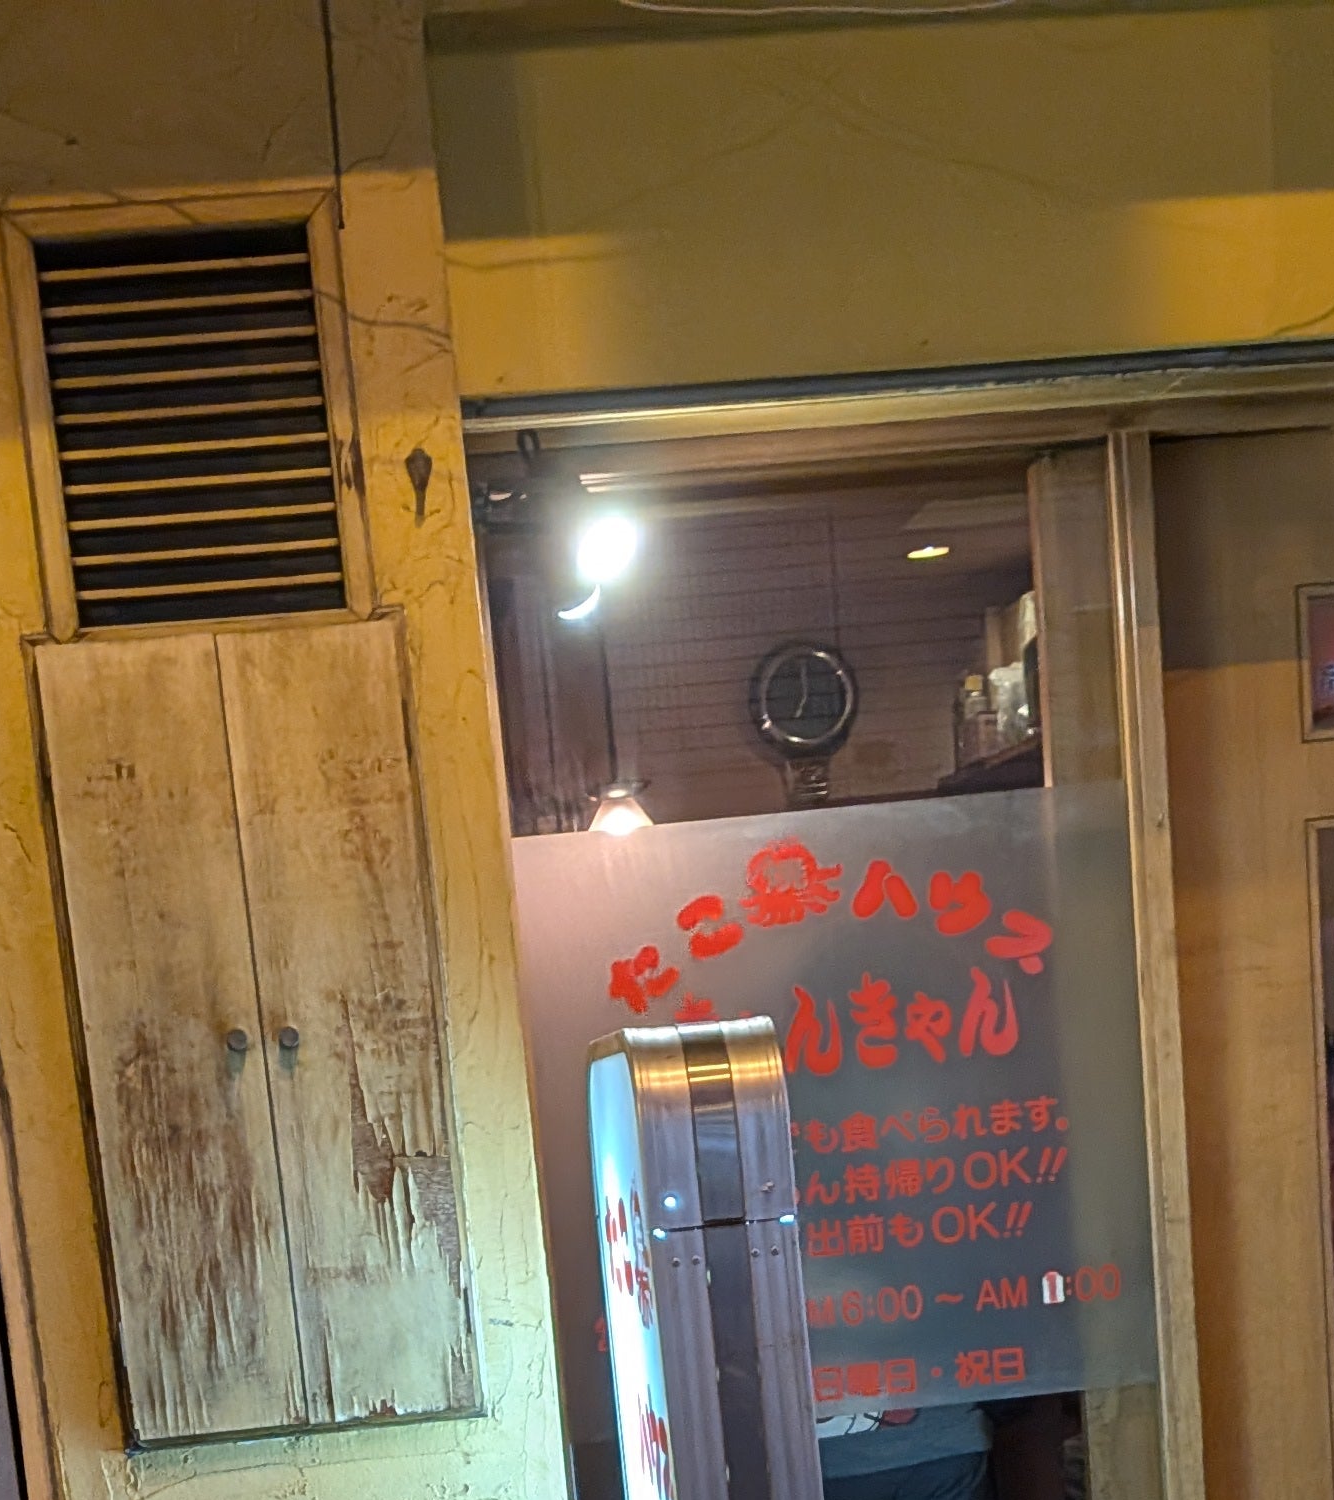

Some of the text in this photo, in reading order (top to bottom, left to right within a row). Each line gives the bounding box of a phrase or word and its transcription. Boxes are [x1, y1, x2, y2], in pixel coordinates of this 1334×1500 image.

[791, 1095, 1069, 1154] も食べられます。
